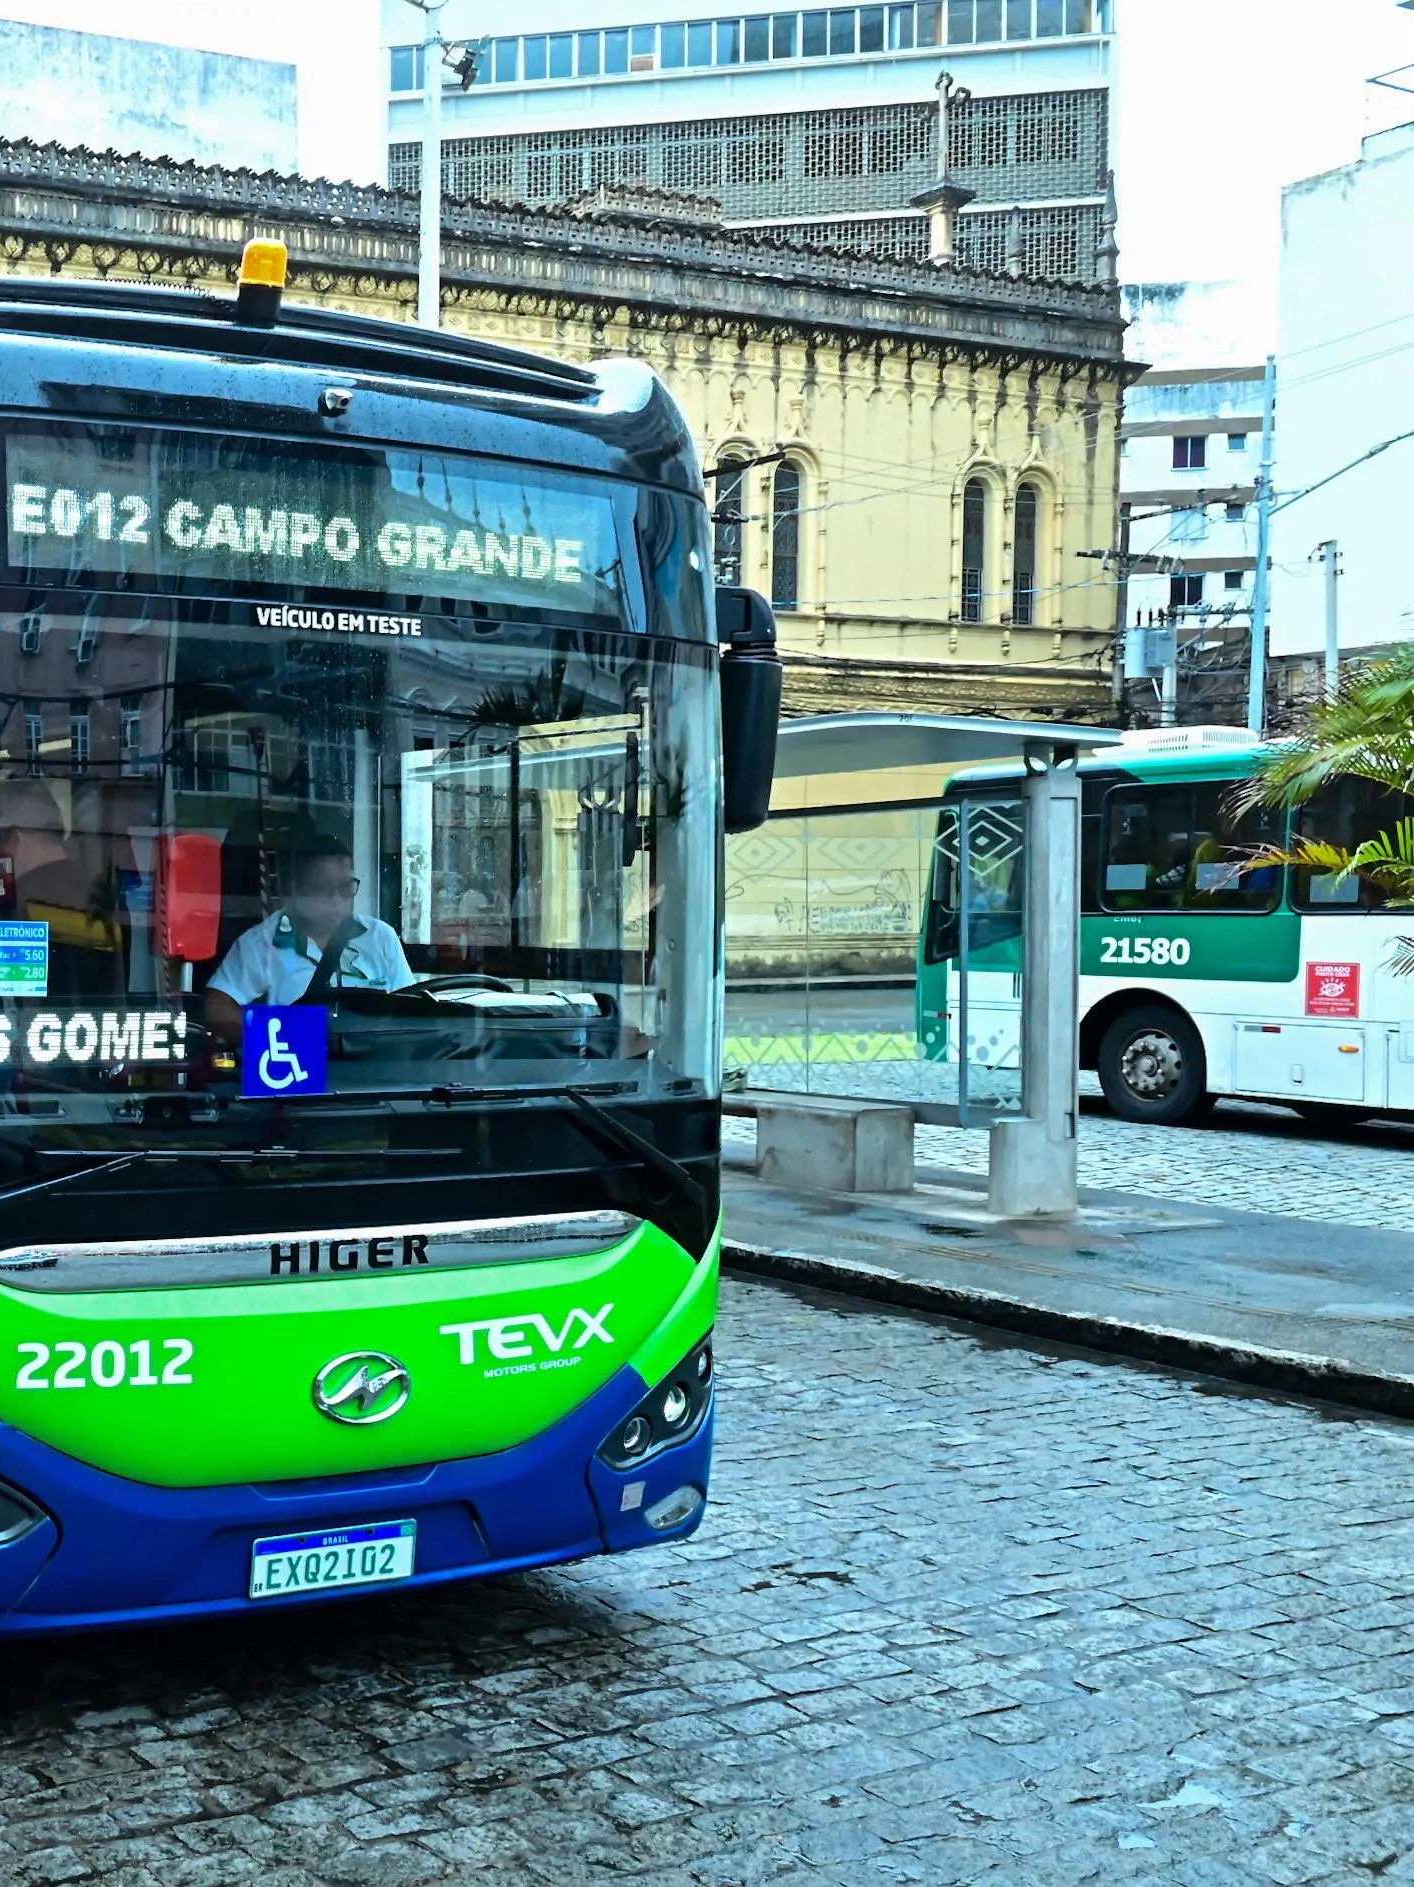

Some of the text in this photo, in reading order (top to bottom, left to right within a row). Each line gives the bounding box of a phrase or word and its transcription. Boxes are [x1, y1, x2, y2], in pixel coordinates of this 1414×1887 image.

[12, 483, 585, 583] E012 CAMPO GRANDE
[257, 604, 422, 637] VEÍCULO EM TESTE
[1100, 936, 1191, 965] 21580
[269, 1234, 431, 1275] HIGER
[439, 1302, 615, 1366] TEVX
[15, 1339, 195, 1389] 22012
[483, 1355, 583, 1379] MOTORS GROUP
[322, 1535, 349, 1546] BRASIL
[254, 1583, 263, 1593] BR
